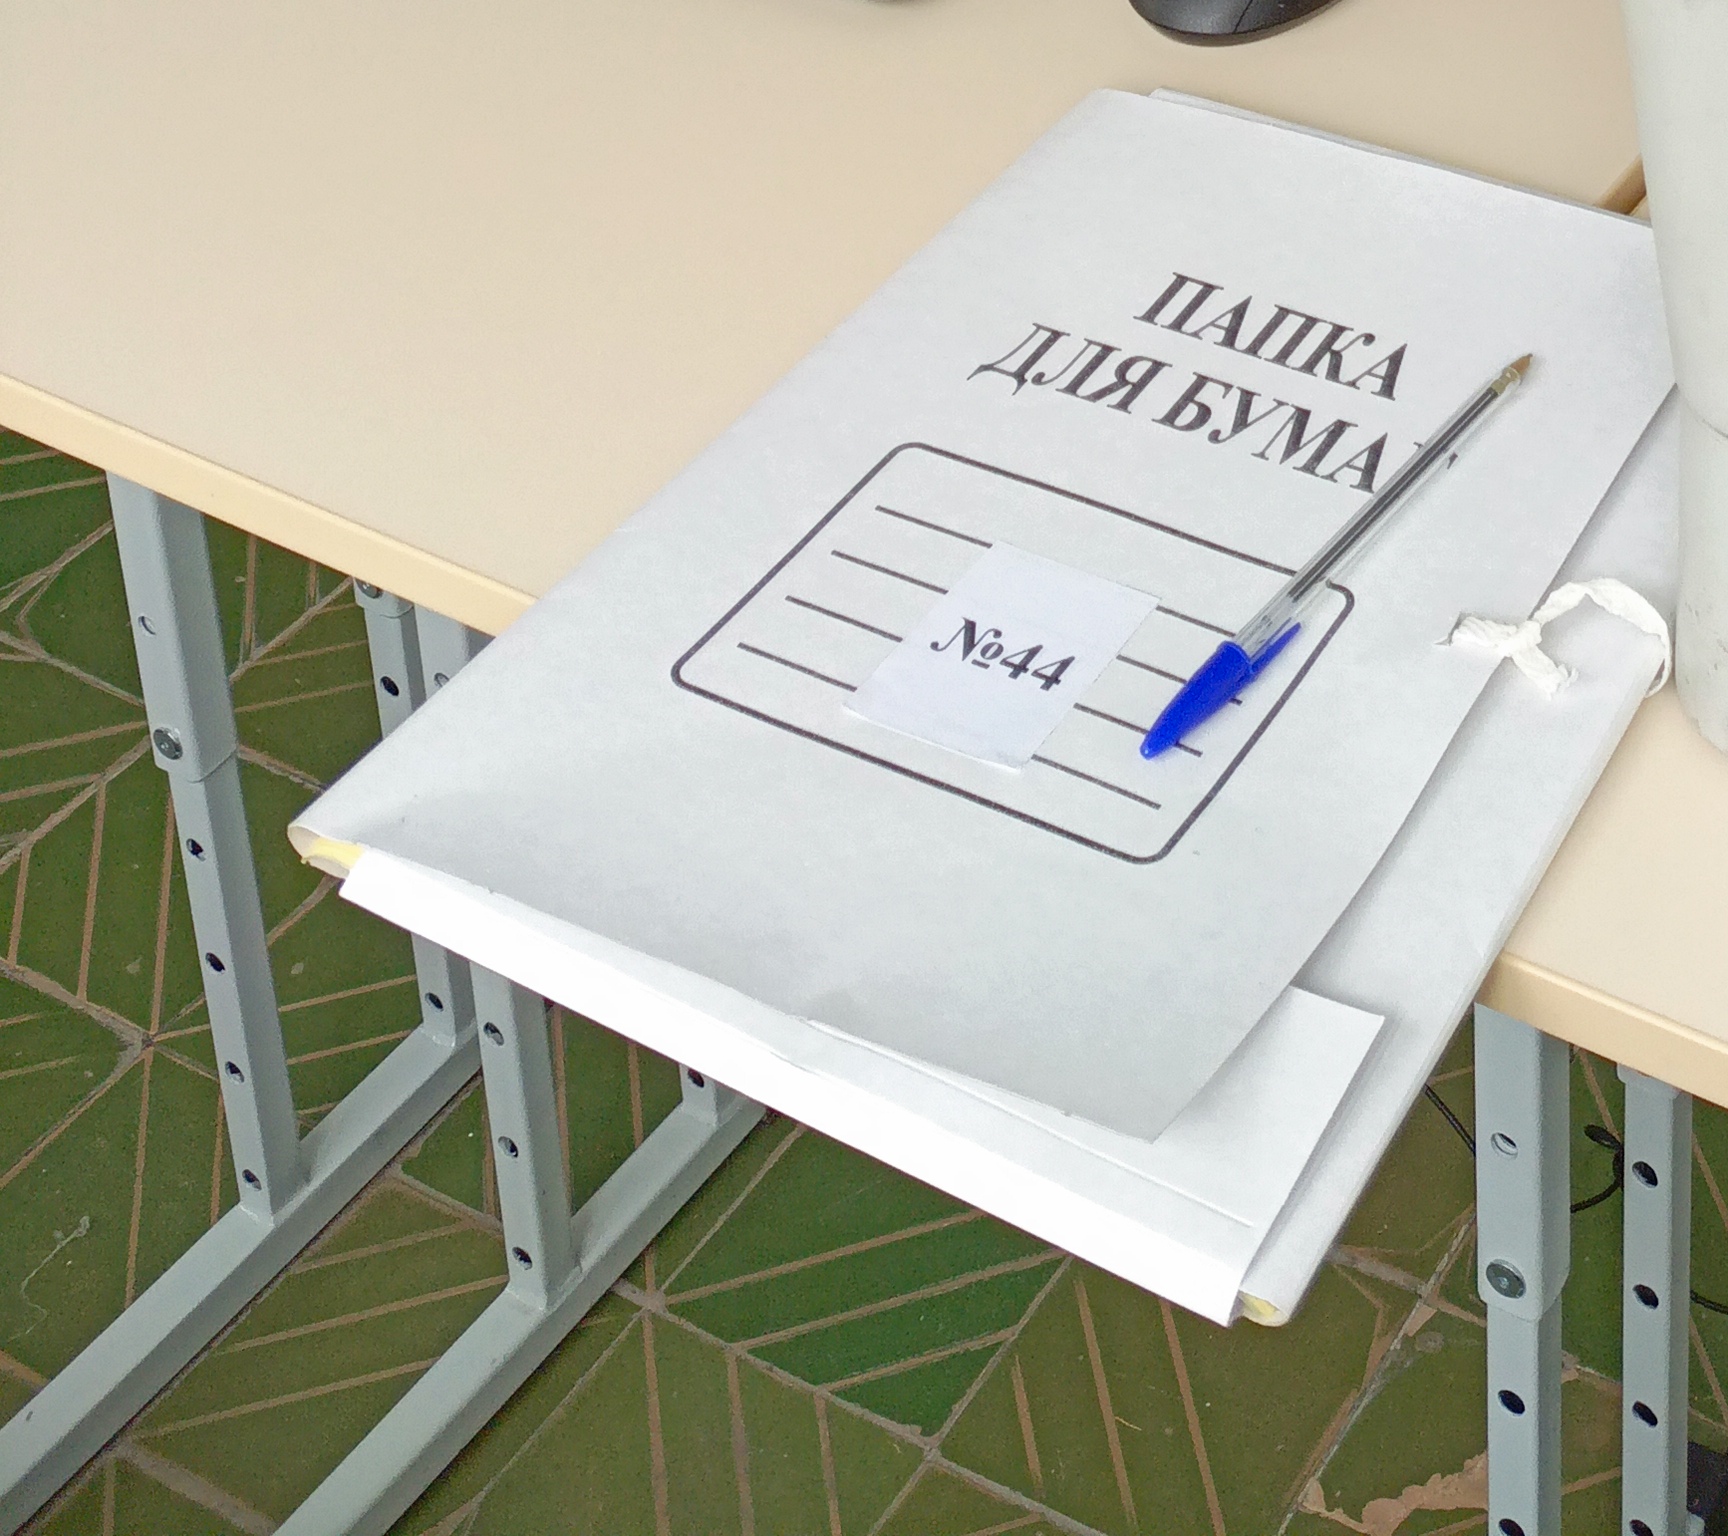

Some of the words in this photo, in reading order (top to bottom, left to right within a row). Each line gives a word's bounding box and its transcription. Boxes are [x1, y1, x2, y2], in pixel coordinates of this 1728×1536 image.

[1134, 271, 1408, 401] ПАПКА
[966, 322, 1173, 415] ДЛЯ
[1151, 372, 1458, 494] БУМА
[929, 616, 1077, 693] №44
